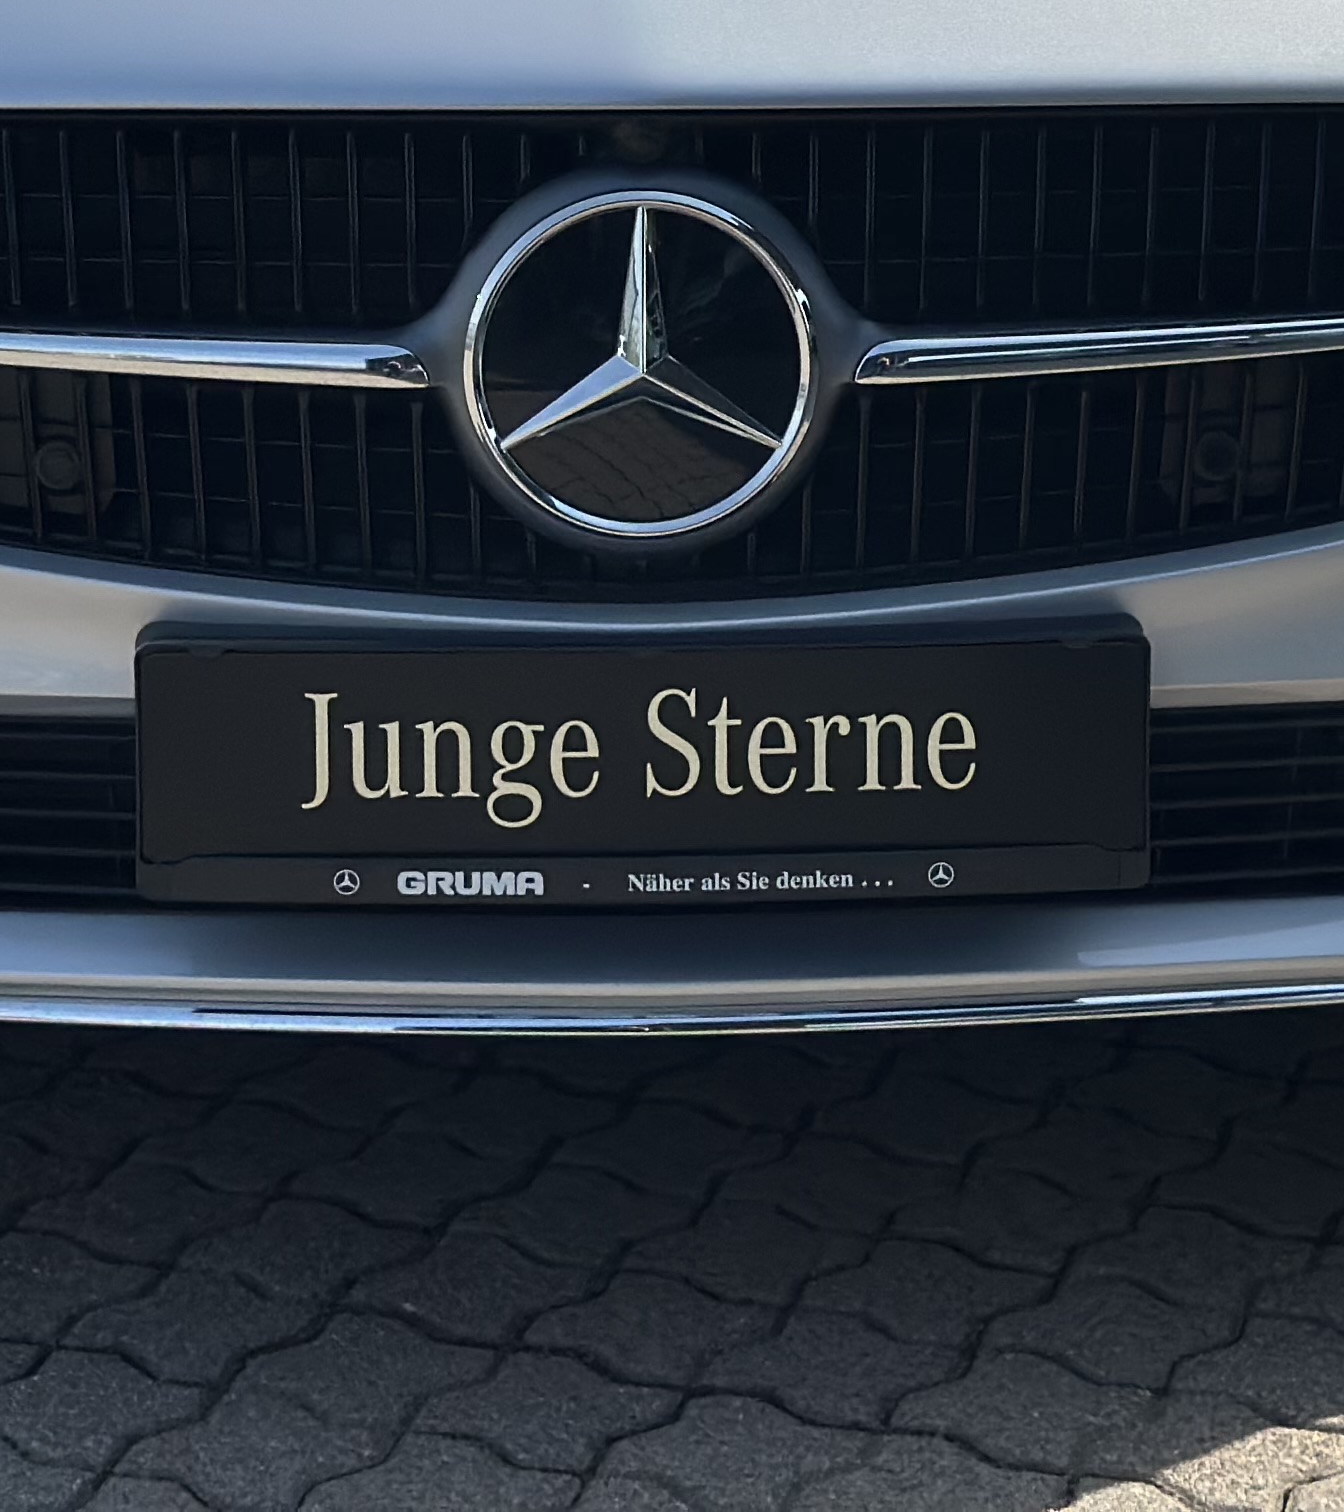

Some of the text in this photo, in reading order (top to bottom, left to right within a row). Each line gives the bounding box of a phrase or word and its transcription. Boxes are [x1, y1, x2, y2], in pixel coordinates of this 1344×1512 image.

[301, 687, 977, 829] Junge Sterne
[396, 870, 545, 896] GRUMA
[627, 872, 695, 893] Näher
[700, 871, 731, 892] als
[736, 871, 770, 891] Sie
[775, 869, 854, 890] denken
